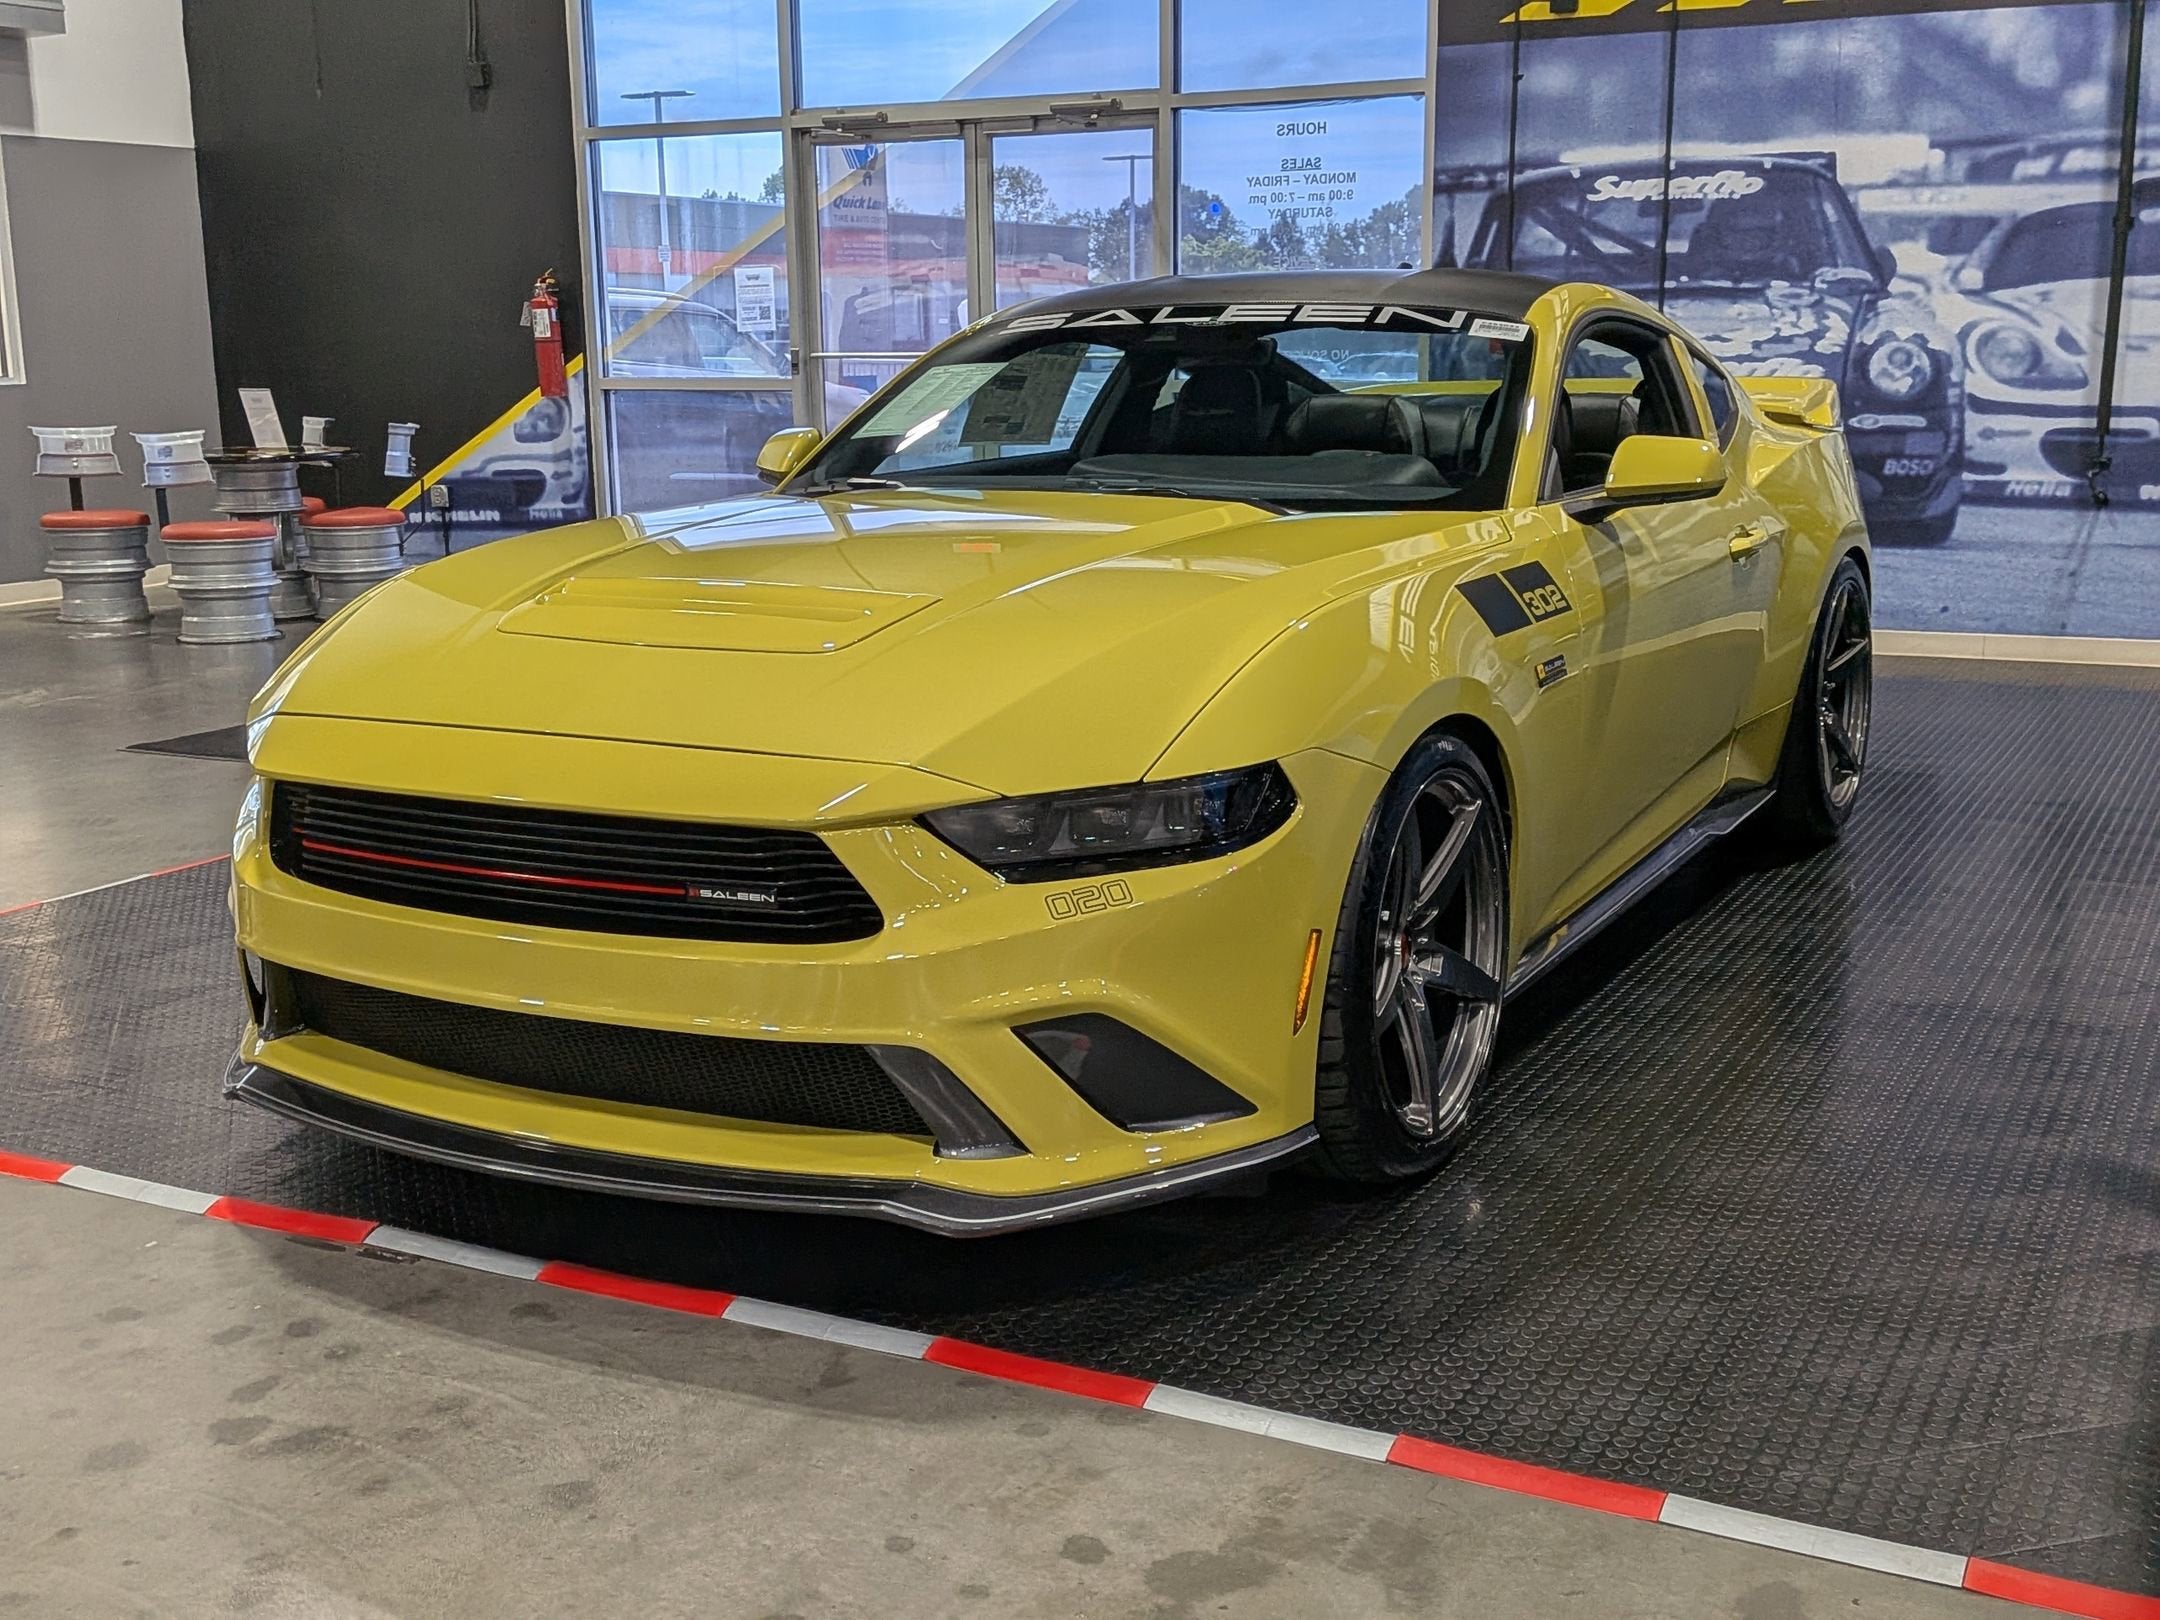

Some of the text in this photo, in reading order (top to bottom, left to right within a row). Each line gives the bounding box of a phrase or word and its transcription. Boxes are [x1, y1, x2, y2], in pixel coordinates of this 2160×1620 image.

[833, 195, 865, 210] Quick
[999, 305, 1468, 335] SALEEN
[1522, 584, 1567, 616] 302
[700, 889, 775, 903] SALEEN
[1044, 879, 1134, 920] 020
